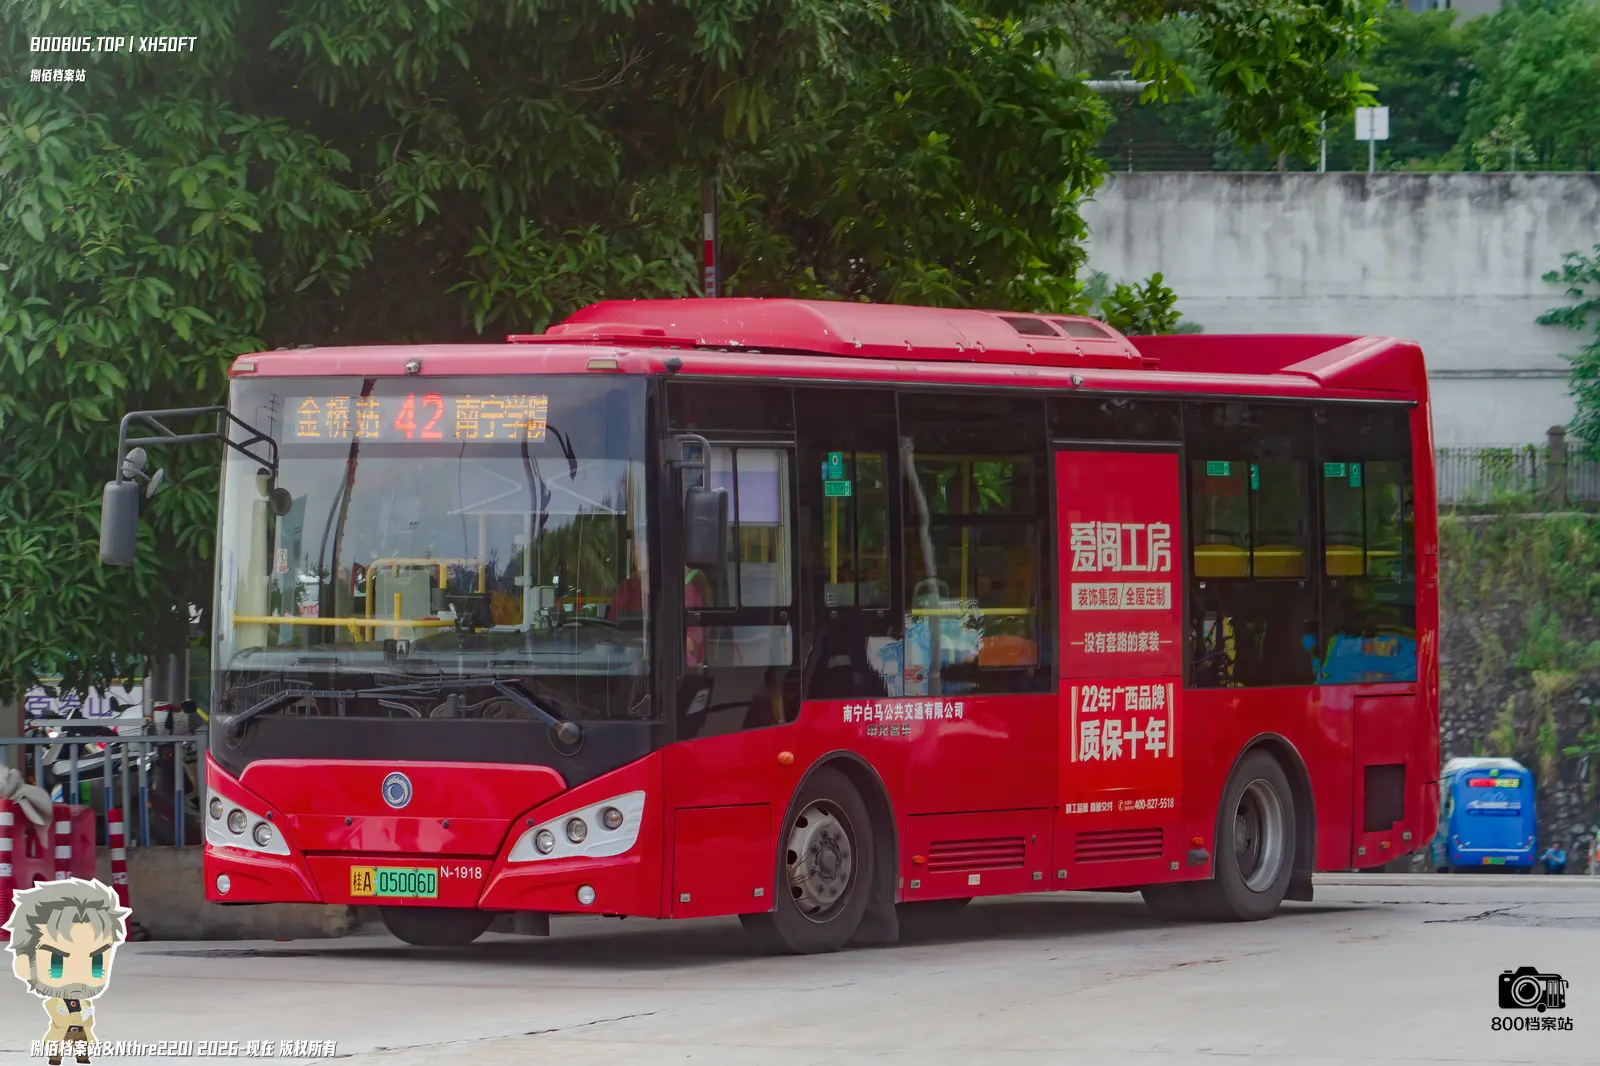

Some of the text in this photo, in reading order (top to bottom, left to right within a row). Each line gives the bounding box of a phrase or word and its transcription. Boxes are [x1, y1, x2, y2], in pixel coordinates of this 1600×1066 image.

[297, 393, 549, 440] 金桥站 42 南宁学院
[1070, 520, 1171, 572] 爱阁工房
[1084, 631, 1160, 653] 没有套路的家装
[1081, 684, 1165, 713] 22年广西品牌
[843, 702, 963, 722] 南宁白马公共交通有限公司
[1079, 716, 1166, 762] 质保十年
[1134, 797, 1174, 810] 400-827-5518
[353, 871, 436, 893] 桂A 05006D
[440, 865, 482, 879] N-1918
